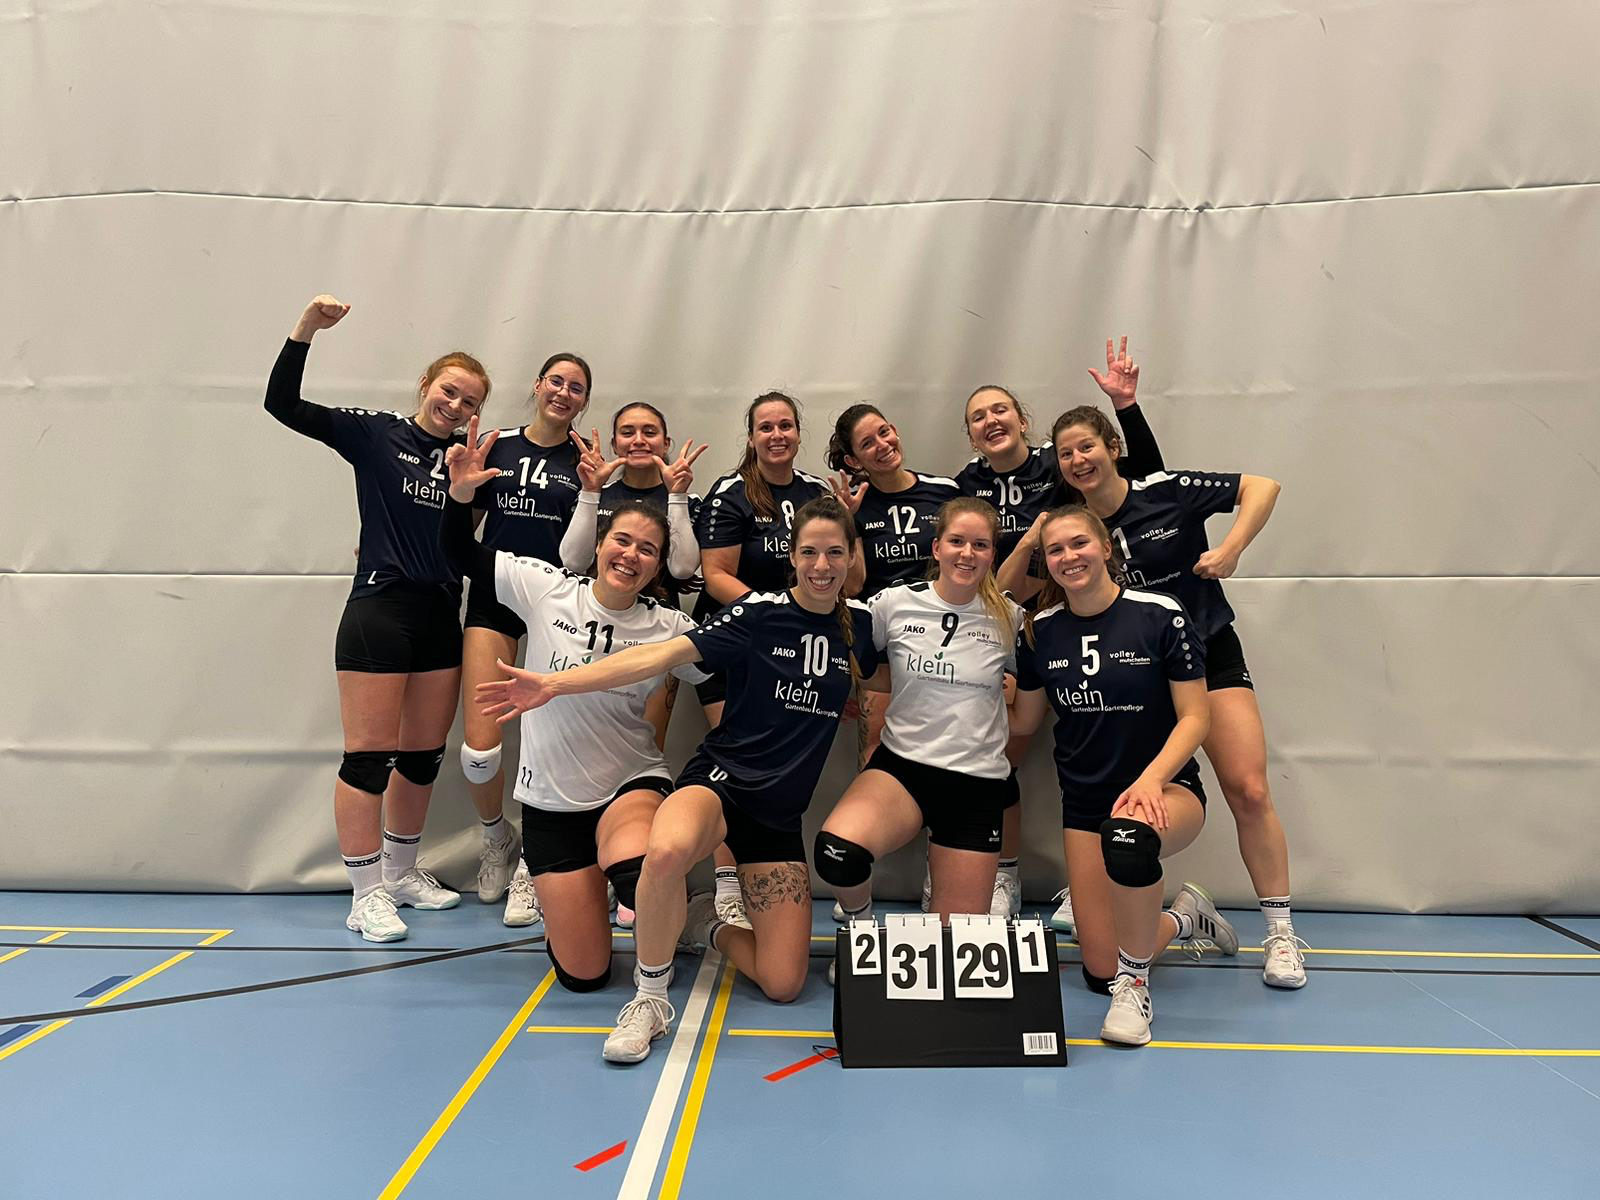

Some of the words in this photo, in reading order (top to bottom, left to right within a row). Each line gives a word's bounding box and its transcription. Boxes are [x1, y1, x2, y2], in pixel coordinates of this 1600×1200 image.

[398, 452, 420, 464] JAKO
[430, 449, 445, 480] 2
[496, 470, 514, 478] AKO
[518, 457, 549, 489] 14
[550, 474, 571, 482] volley
[402, 477, 446, 510] klein
[497, 488, 536, 517] klein
[993, 476, 1023, 506] 16
[781, 500, 795, 530] 8
[865, 521, 885, 530] JAKO
[887, 505, 920, 535] 12
[764, 536, 789, 552] kle
[875, 536, 918, 560] klein
[1141, 528, 1164, 539] volley
[552, 618, 577, 635] JAKO
[585, 620, 614, 654] 11
[902, 625, 926, 634] JAKO
[941, 612, 959, 647] 9
[967, 631, 990, 639] volley
[772, 647, 796, 658] JAKO
[800, 633, 829, 677] 10
[906, 652, 954, 684] klein
[1047, 659, 1069, 670] JAKO
[1081, 634, 1100, 676] 5
[1109, 650, 1135, 659] volley
[775, 680, 818, 713] klein
[1056, 680, 1104, 711] klein
[855, 934, 876, 969] 2
[892, 943, 938, 989] 31
[956, 943, 1009, 988] 29
[1022, 932, 1040, 966] 1
